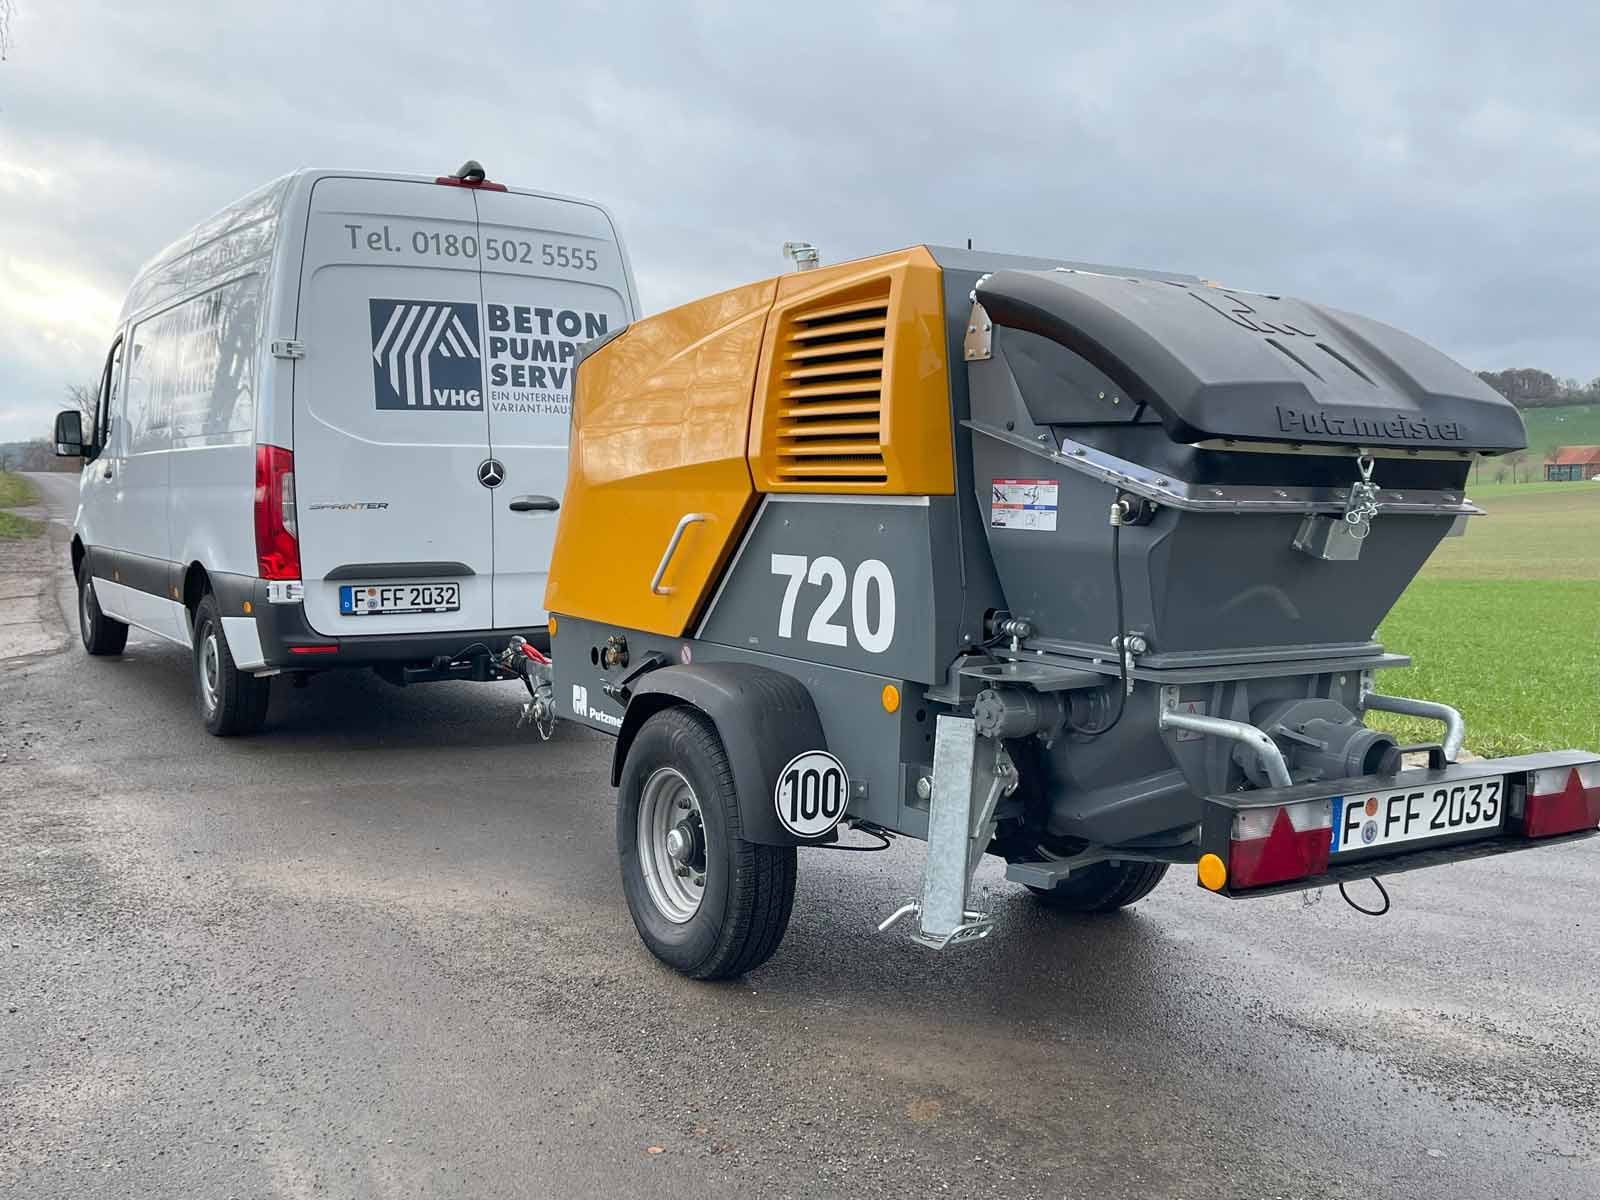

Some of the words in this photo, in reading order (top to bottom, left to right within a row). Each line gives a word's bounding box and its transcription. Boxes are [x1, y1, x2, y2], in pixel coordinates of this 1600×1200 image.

[344, 224, 401, 252] Tel.
[412, 231, 478, 258] 0180
[485, 238, 534, 264] 502
[542, 244, 598, 271] 5555
[488, 303, 608, 338] BETON
[490, 336, 578, 363] PUMP
[433, 388, 481, 407] VHG
[491, 391, 510, 401] EIN
[513, 391, 571, 404] UNTERNEH
[1275, 405, 1466, 441] Putzmeister
[308, 502, 389, 511] SPRINTER
[354, 589, 367, 608] F
[380, 588, 405, 607] FF
[409, 586, 457, 606] 2032
[771, 553, 896, 653] 720
[784, 767, 842, 823] 100
[1343, 801, 1365, 845] F
[1384, 792, 1425, 838] FF
[1430, 781, 1500, 831] 2033
